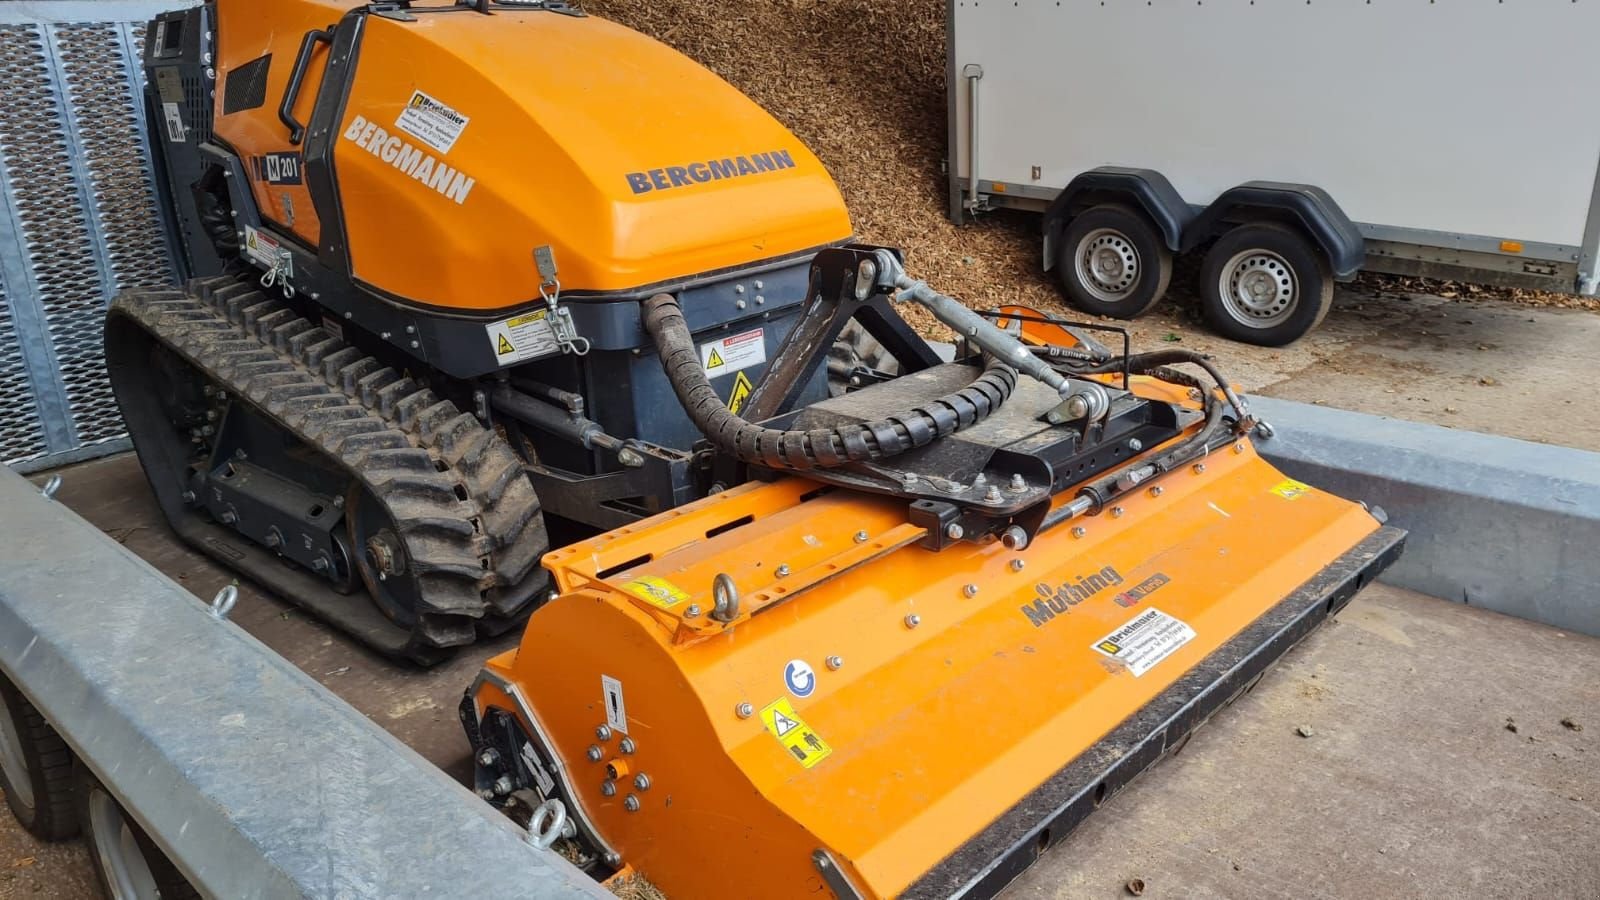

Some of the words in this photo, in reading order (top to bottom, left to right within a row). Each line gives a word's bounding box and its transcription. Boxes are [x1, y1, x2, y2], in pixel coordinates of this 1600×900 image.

[343, 114, 476, 205] BERGMANN
[625, 149, 796, 194] BERGMANN
[1108, 610, 1158, 644] Brielmaier
